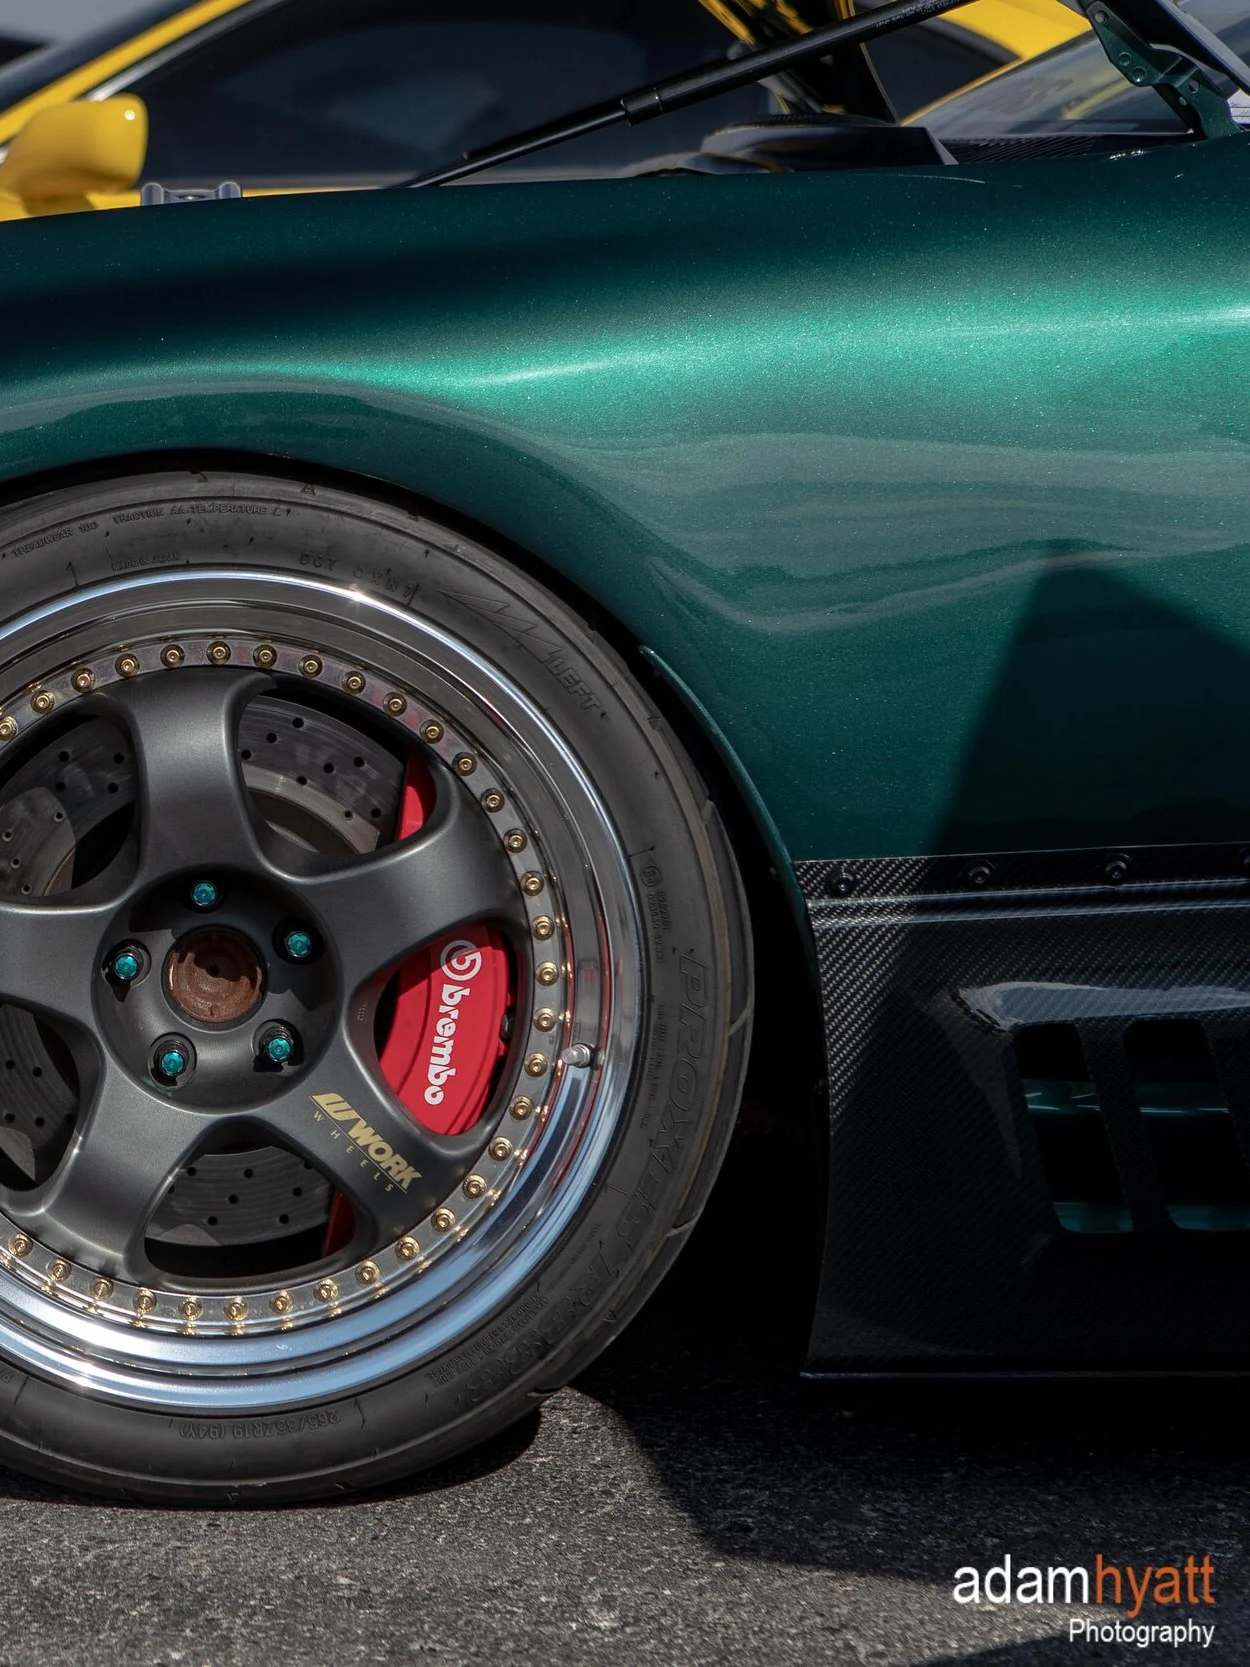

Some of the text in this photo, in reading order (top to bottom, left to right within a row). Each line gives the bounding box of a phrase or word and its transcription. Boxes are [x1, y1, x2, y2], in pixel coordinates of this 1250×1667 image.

[12, 528, 74, 559] TREADWEAR
[78, 520, 99, 534] 100
[112, 507, 165, 524] TRACTION
[191, 503, 268, 516] TEMPERATURE
[111, 558, 137, 571] MADE
[150, 551, 181, 564] JAPAN
[548, 656, 602, 712] LEFT
[424, 983, 470, 1106] brembo
[313, 1111, 393, 1192] WHEELS
[349, 1119, 422, 1191] WORK
